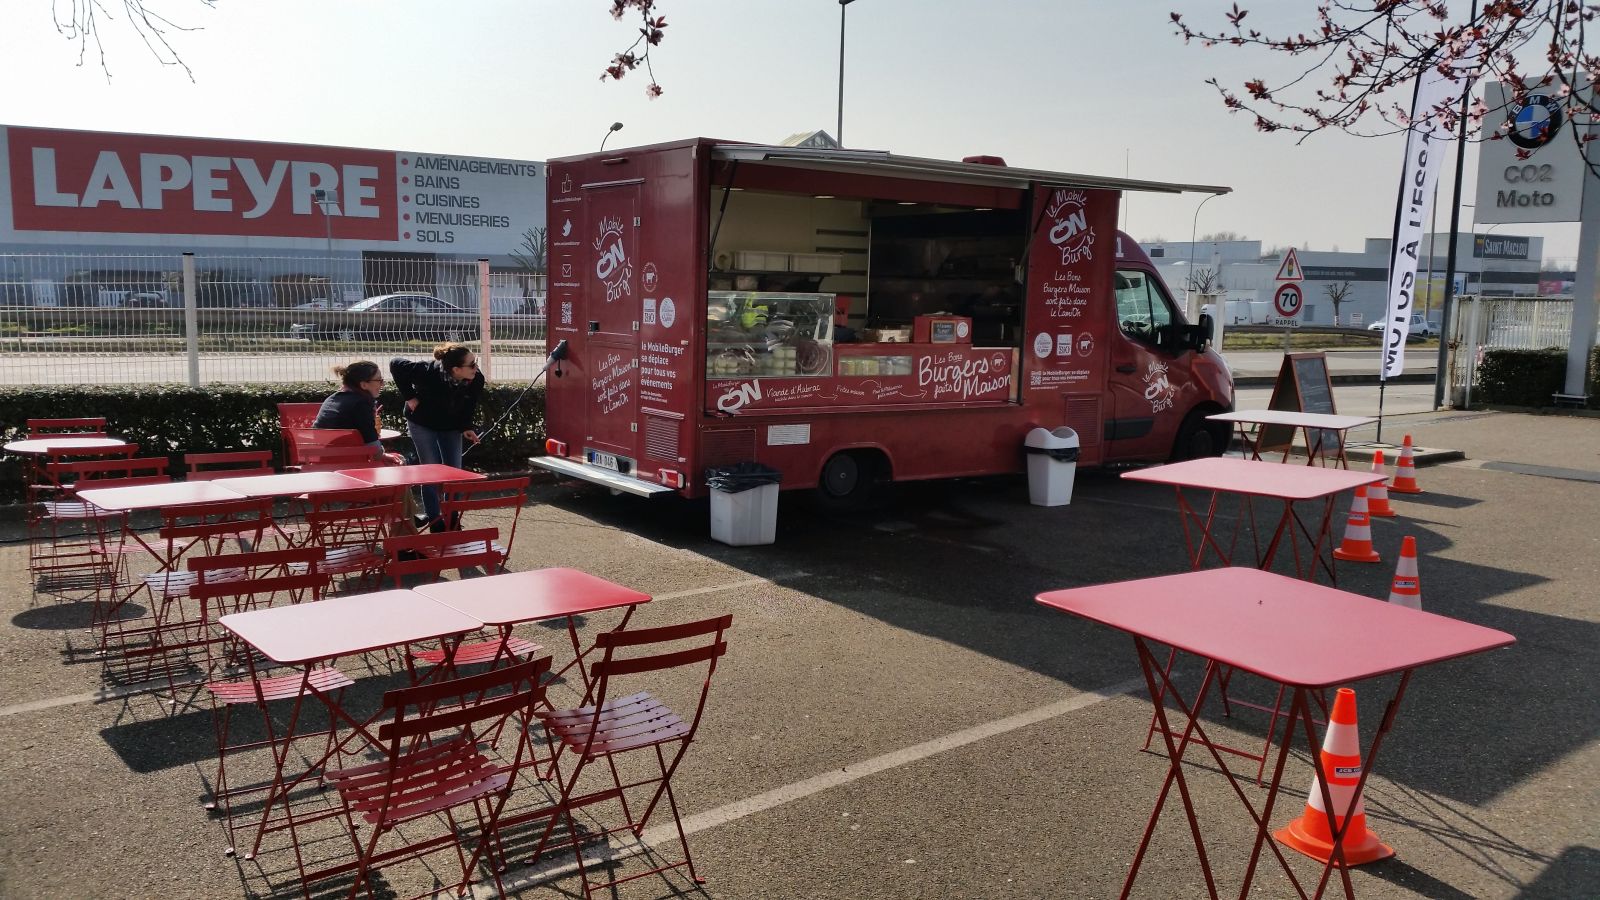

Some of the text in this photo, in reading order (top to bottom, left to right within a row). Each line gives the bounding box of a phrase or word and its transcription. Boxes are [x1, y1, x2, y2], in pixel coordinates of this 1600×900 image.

[1511, 96, 1559, 116] BMW
[414, 156, 537, 177] AMÉNAGEMENTS
[1503, 164, 1553, 184] CO2
[32, 147, 380, 218] LAPEYRE
[414, 175, 460, 189] BAINS
[415, 193, 480, 208] CUISINES
[1055, 189, 1087, 206] Mobile
[1496, 189, 1555, 208] Moto
[415, 212, 510, 228] MENUISERIES
[599, 215, 624, 237] Mobile
[1049, 209, 1088, 245] ON
[416, 230, 455, 243] SOLS
[1062, 226, 1096, 266] Burger
[1401, 240, 1419, 260] À
[1484, 239, 1528, 257] SAINT MACLOU
[596, 237, 626, 279] ON
[606, 257, 633, 302] Burger
[1054, 270, 1065, 280] Les
[1043, 282, 1091, 300] Burgers Maison
[1281, 293, 1299, 308] 70
[1275, 319, 1299, 327] RAPPEL
[641, 340, 685, 356] le MobileBurger
[598, 360, 608, 372] Les
[648, 353, 669, 366] déplace
[934, 352, 963, 365] Les Bons
[640, 366, 676, 379] pour tous vos
[918, 355, 989, 393] Burgers
[640, 376, 673, 390] événements
[766, 384, 821, 398] Viande d'Aubrac
[933, 373, 1012, 400] faits Maison
[1145, 374, 1169, 399] ON
[717, 379, 762, 415] ON
[1152, 385, 1175, 413] Burger
